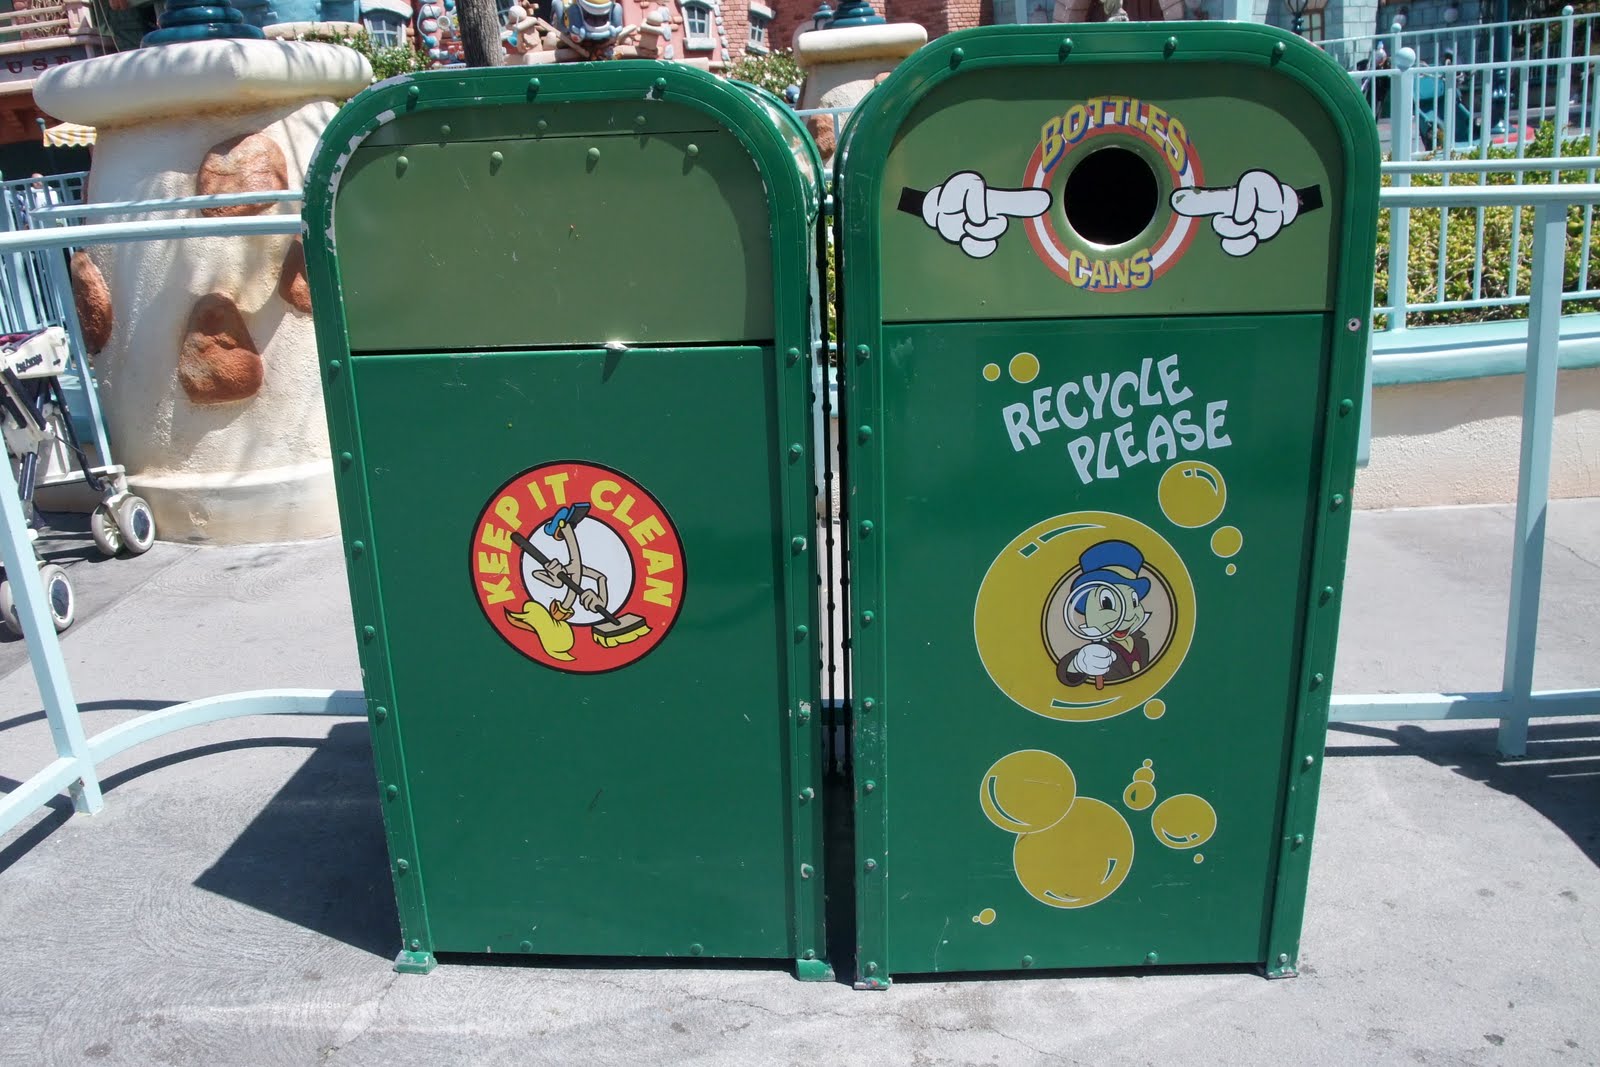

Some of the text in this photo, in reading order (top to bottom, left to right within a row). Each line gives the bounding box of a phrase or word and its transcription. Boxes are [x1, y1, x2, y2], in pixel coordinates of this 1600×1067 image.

[1041, 96, 1190, 175] BOTTLES
[1068, 248, 1153, 288] CANS
[1003, 354, 1193, 451] RECYCLE
[1067, 400, 1232, 484] PLEASE
[478, 472, 674, 607] KEEP IT CLEAN
